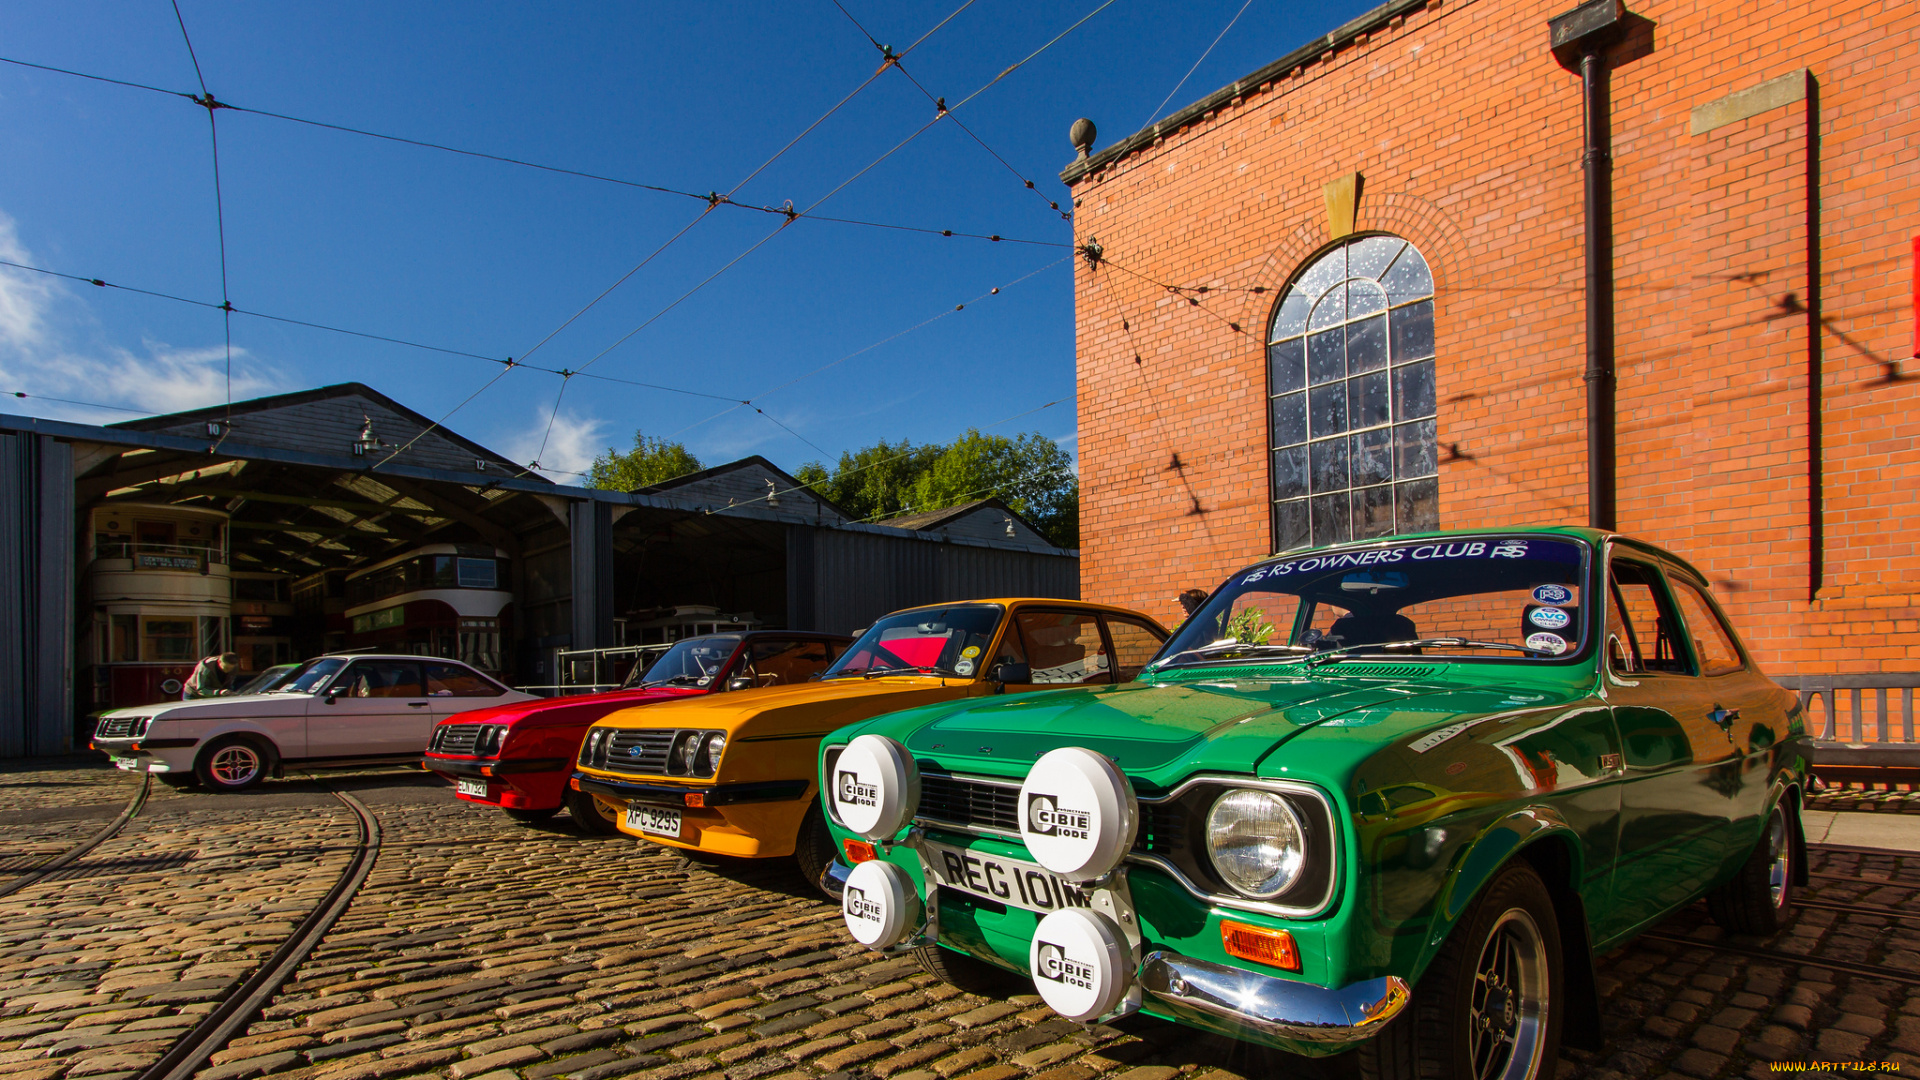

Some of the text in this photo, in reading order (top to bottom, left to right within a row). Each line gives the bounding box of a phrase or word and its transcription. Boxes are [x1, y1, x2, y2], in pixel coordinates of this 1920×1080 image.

[207, 423, 220, 436] 10
[353, 443, 363, 455] 11
[475, 460, 485, 470] 12
[1268, 561, 1297, 578] RS
[1298, 548, 1406, 572] OWNERS
[1411, 542, 1487, 560] CLUB
[1533, 612, 1567, 620] AVO
[628, 804, 679, 832] XPC 929S
[1058, 828, 1088, 840] IODE
[942, 850, 1011, 900] REG
[1065, 976, 1092, 990] IODE
